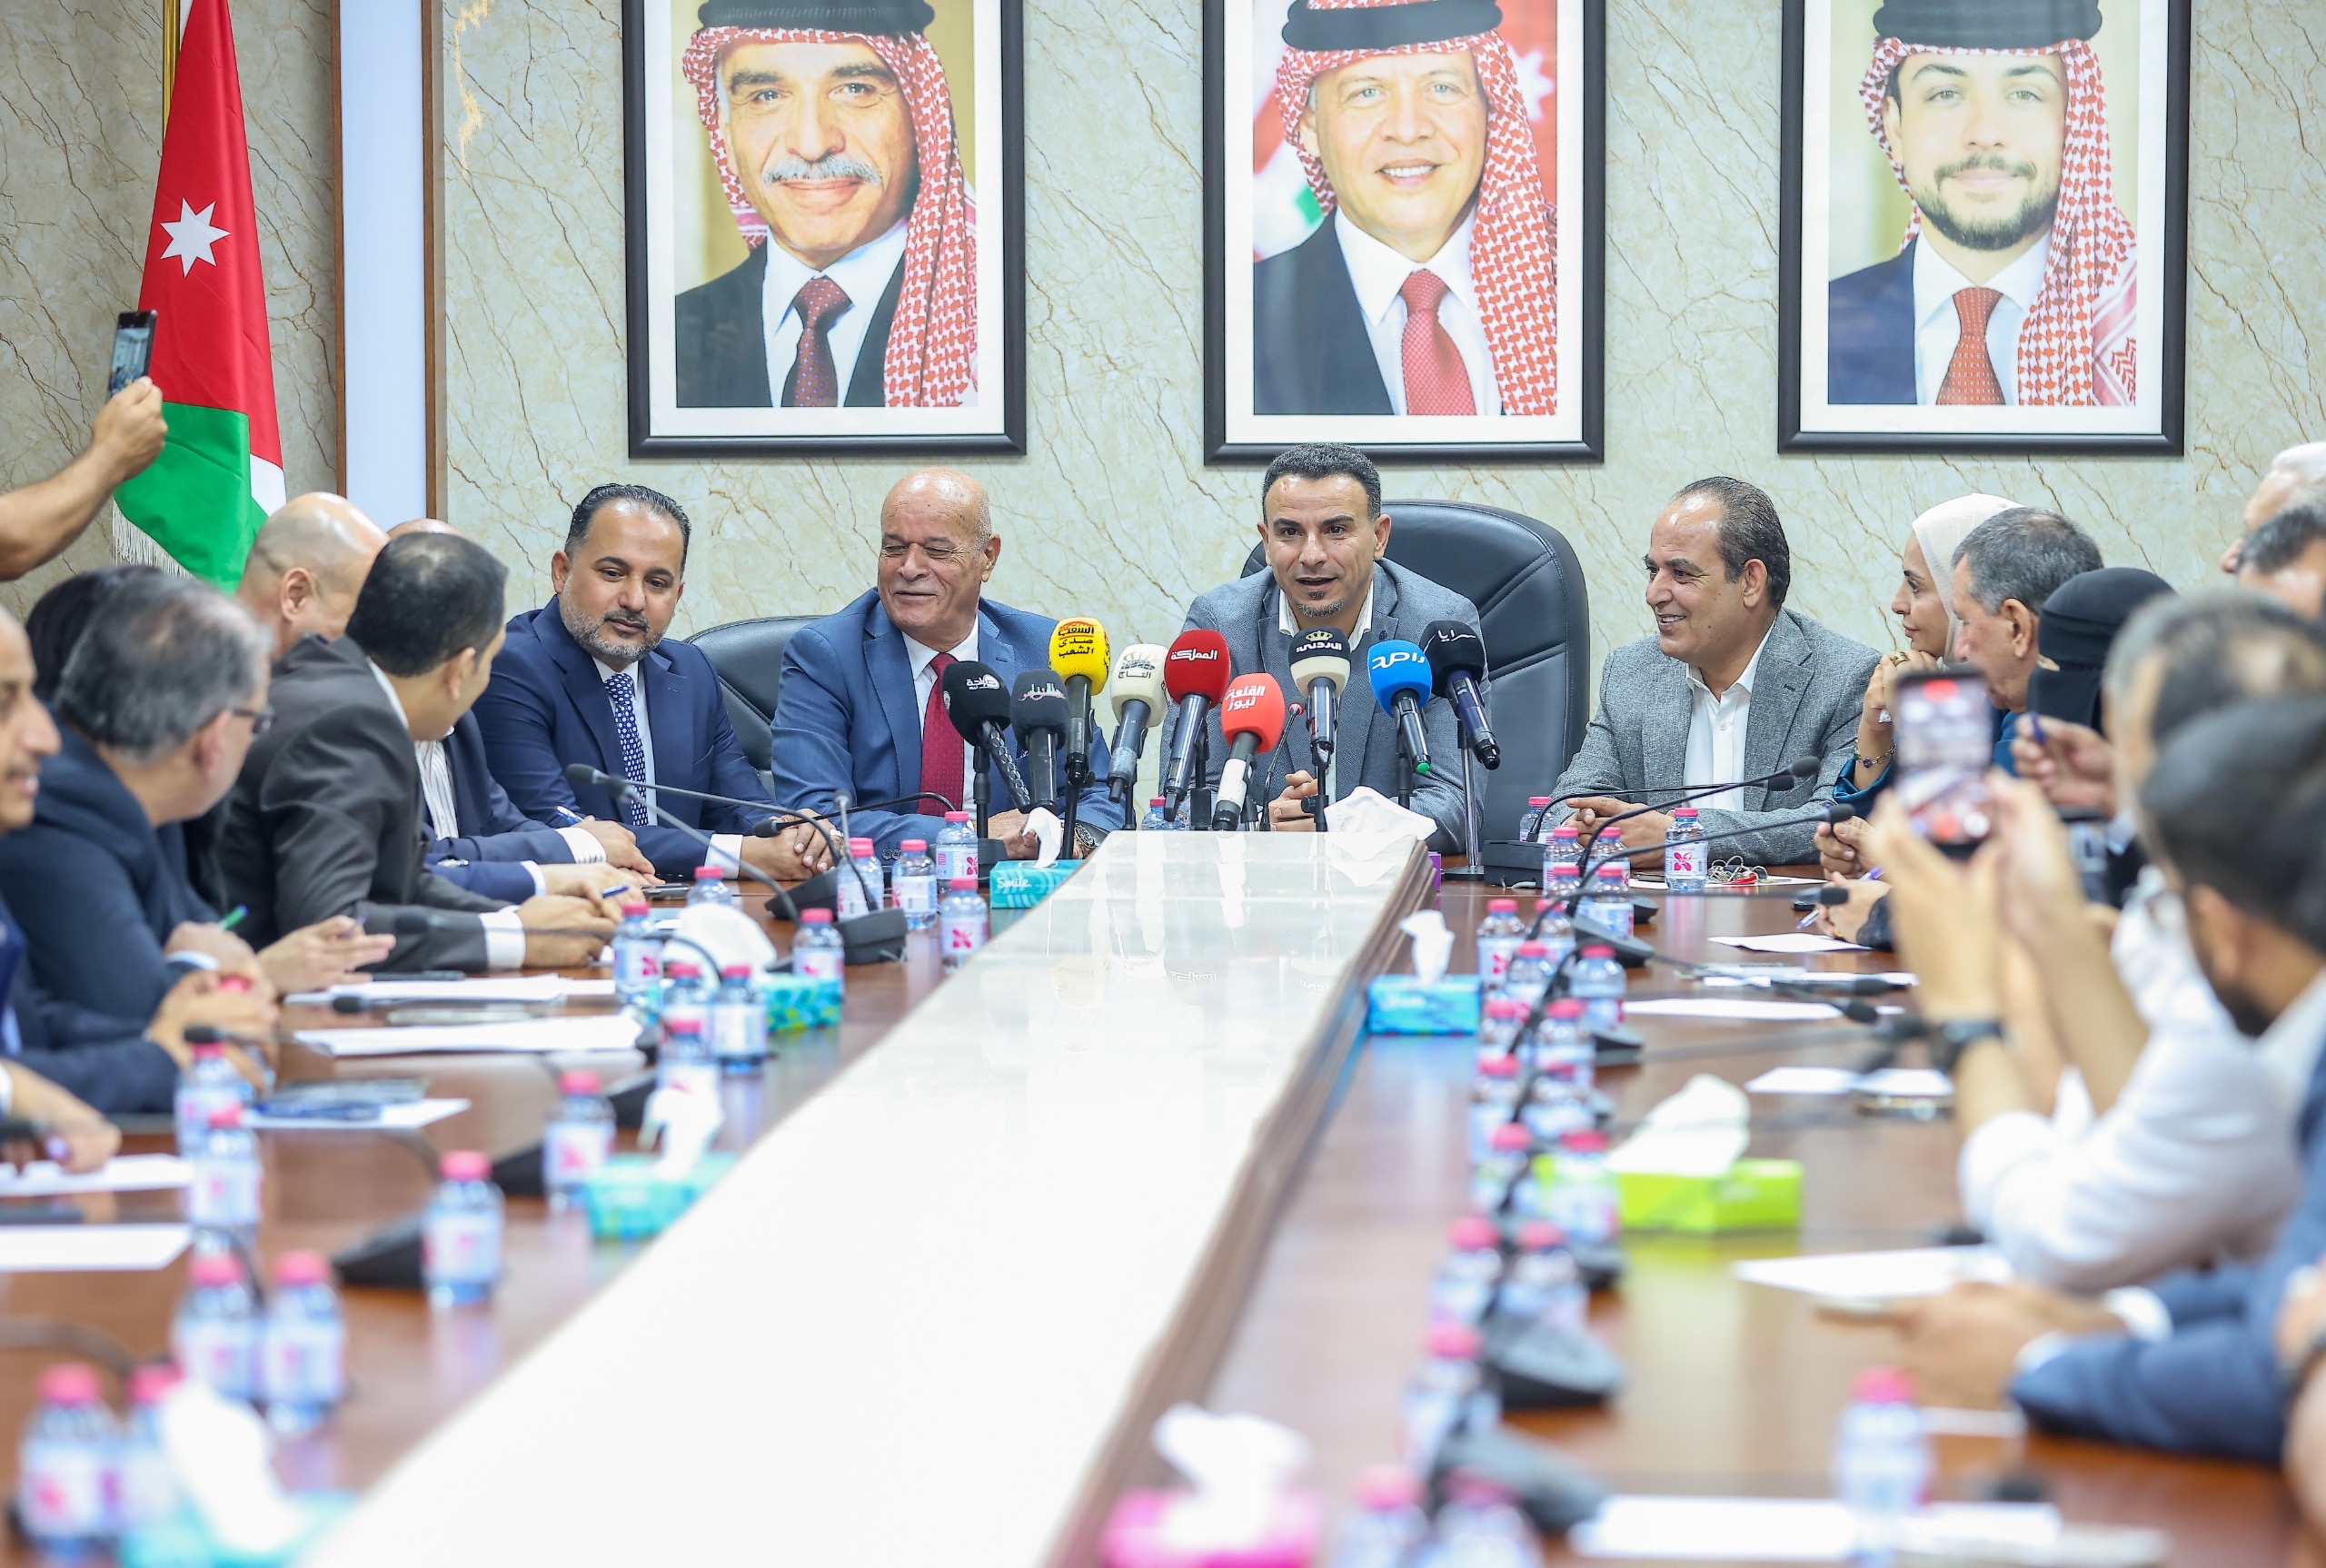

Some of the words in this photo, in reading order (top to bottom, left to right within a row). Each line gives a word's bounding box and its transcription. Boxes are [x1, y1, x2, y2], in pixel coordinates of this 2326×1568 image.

[1059, 646, 1094, 658] الشعب
[1170, 648, 1218, 660] المملكة
[1372, 652, 1425, 670] راصد
[1225, 685, 1267, 700] القلعة
[1227, 697, 1257, 712] نيوز
